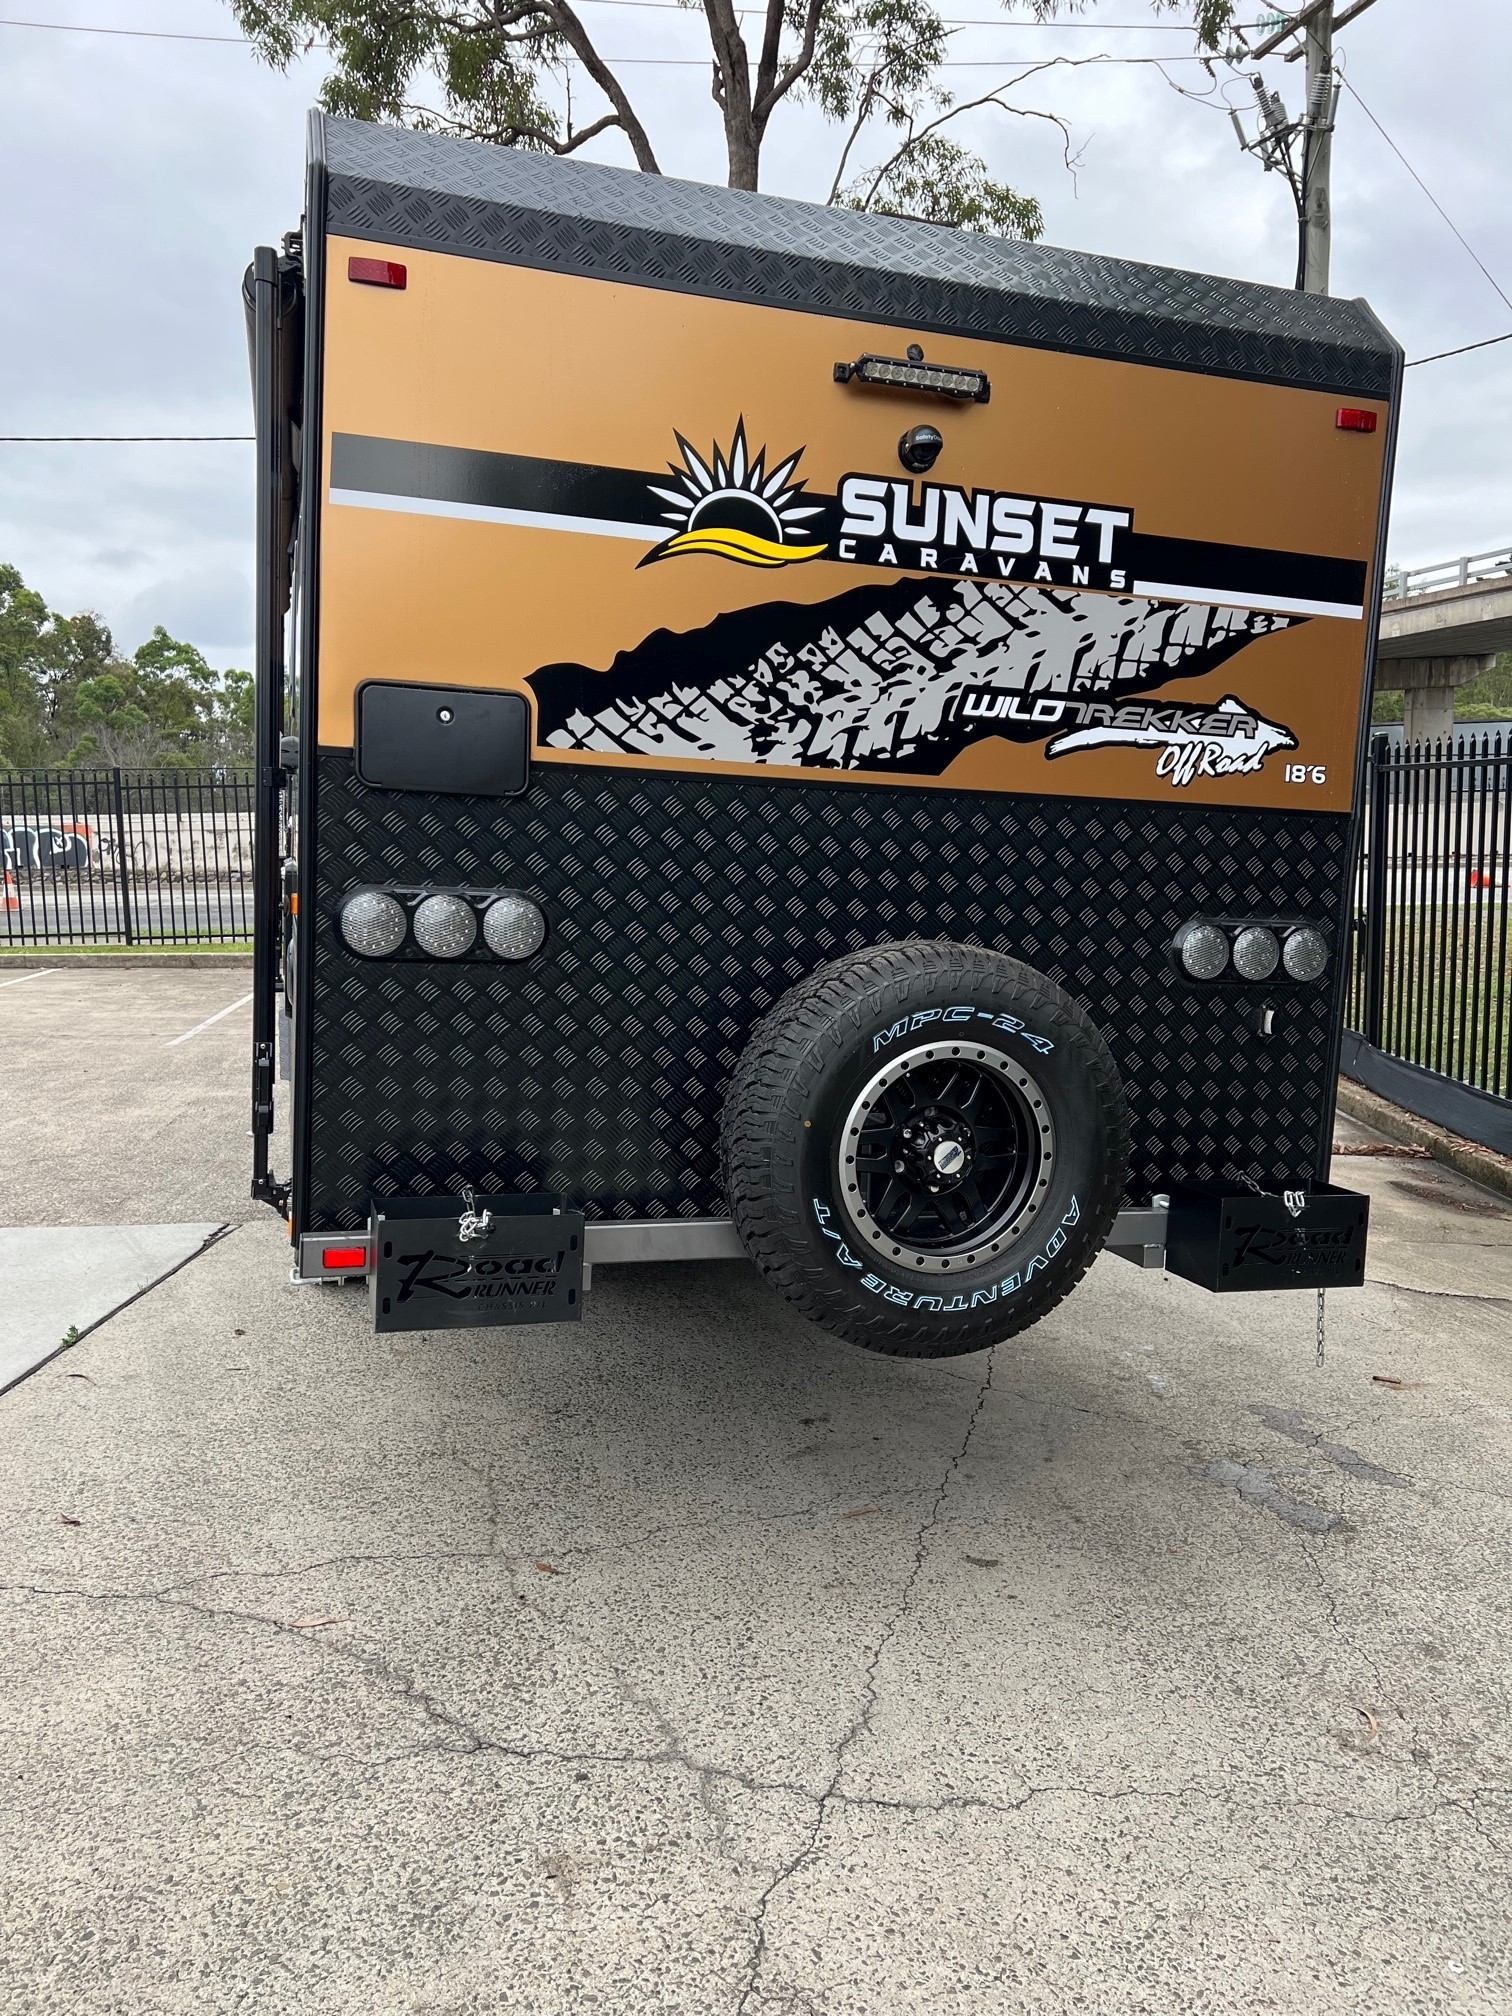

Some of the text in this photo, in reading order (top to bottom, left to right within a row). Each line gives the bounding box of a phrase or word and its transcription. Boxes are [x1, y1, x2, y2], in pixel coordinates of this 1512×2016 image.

[840, 478, 1129, 563] SUNSET
[839, 538, 1127, 589] CARAVANS
[1285, 764, 1327, 785] 18'6
[873, 1006, 1055, 1054] MPC-24
[396, 1249, 566, 1304] Road
[813, 1194, 1081, 1312] ADVENTURE A/T
[473, 1280, 556, 1299] RUNNER
